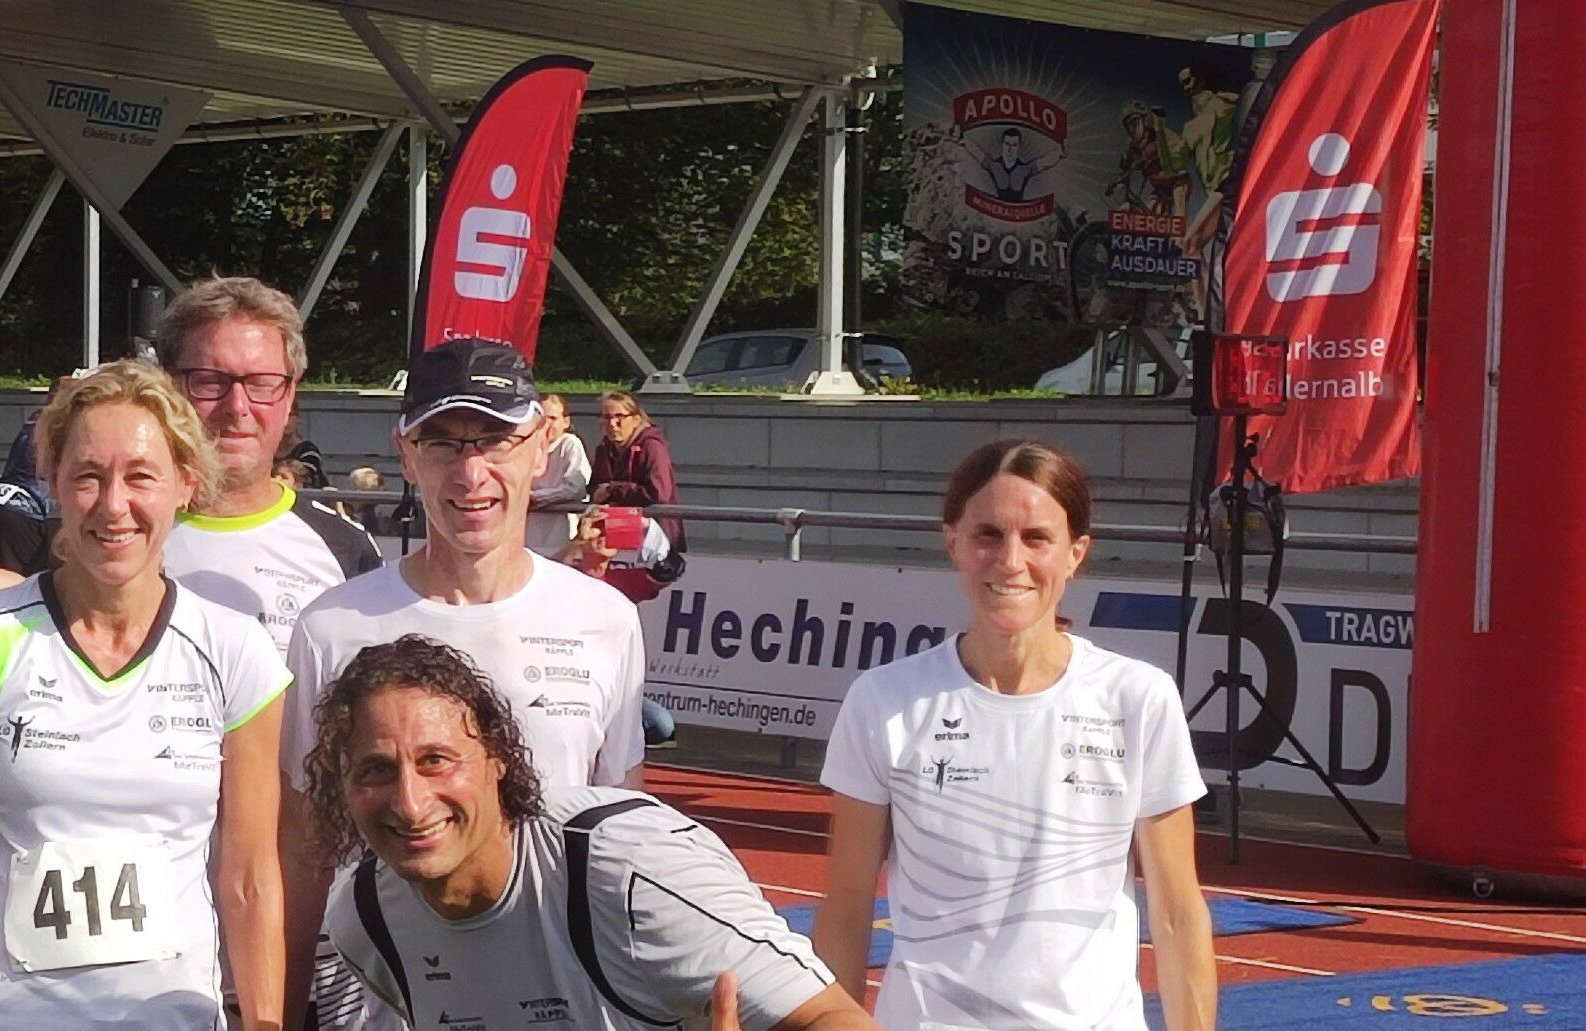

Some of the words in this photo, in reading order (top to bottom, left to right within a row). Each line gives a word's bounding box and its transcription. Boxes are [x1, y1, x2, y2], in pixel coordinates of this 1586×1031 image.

[964, 95, 1057, 131] APOLLO
[1112, 212, 1182, 235] ENERGIE
[947, 231, 1069, 269] SPORT
[1110, 255, 1197, 278] AUSDAUER
[648, 657, 721, 679] Werkstatt
[33, 862, 147, 940] 414
